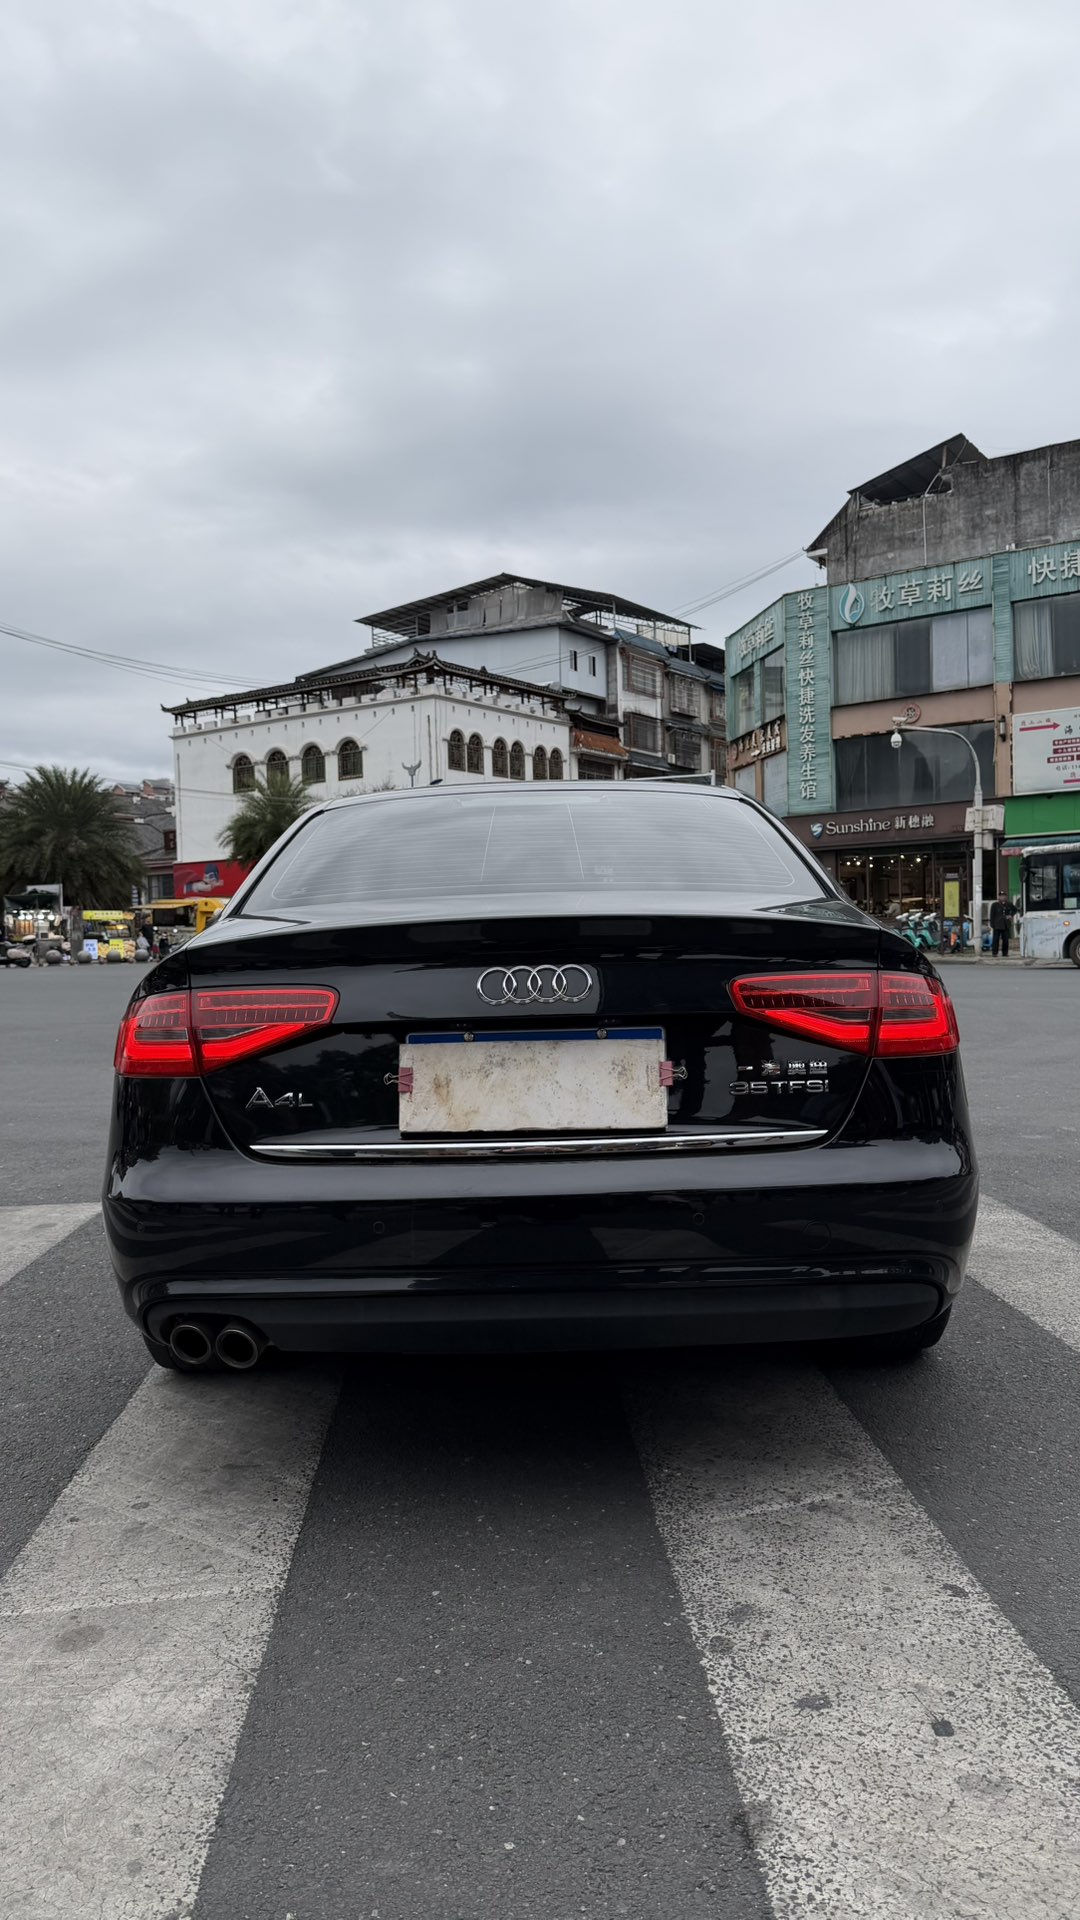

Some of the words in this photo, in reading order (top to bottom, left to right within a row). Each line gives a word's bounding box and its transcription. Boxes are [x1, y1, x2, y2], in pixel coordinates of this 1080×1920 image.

[1027, 548, 1080, 585] 快捷
[870, 569, 984, 613] 牧草莉丝
[798, 592, 817, 801] 牧草莉丝快捷洗发养生馆
[825, 818, 891, 836] Sunshine
[245, 1086, 314, 1110] A4L
